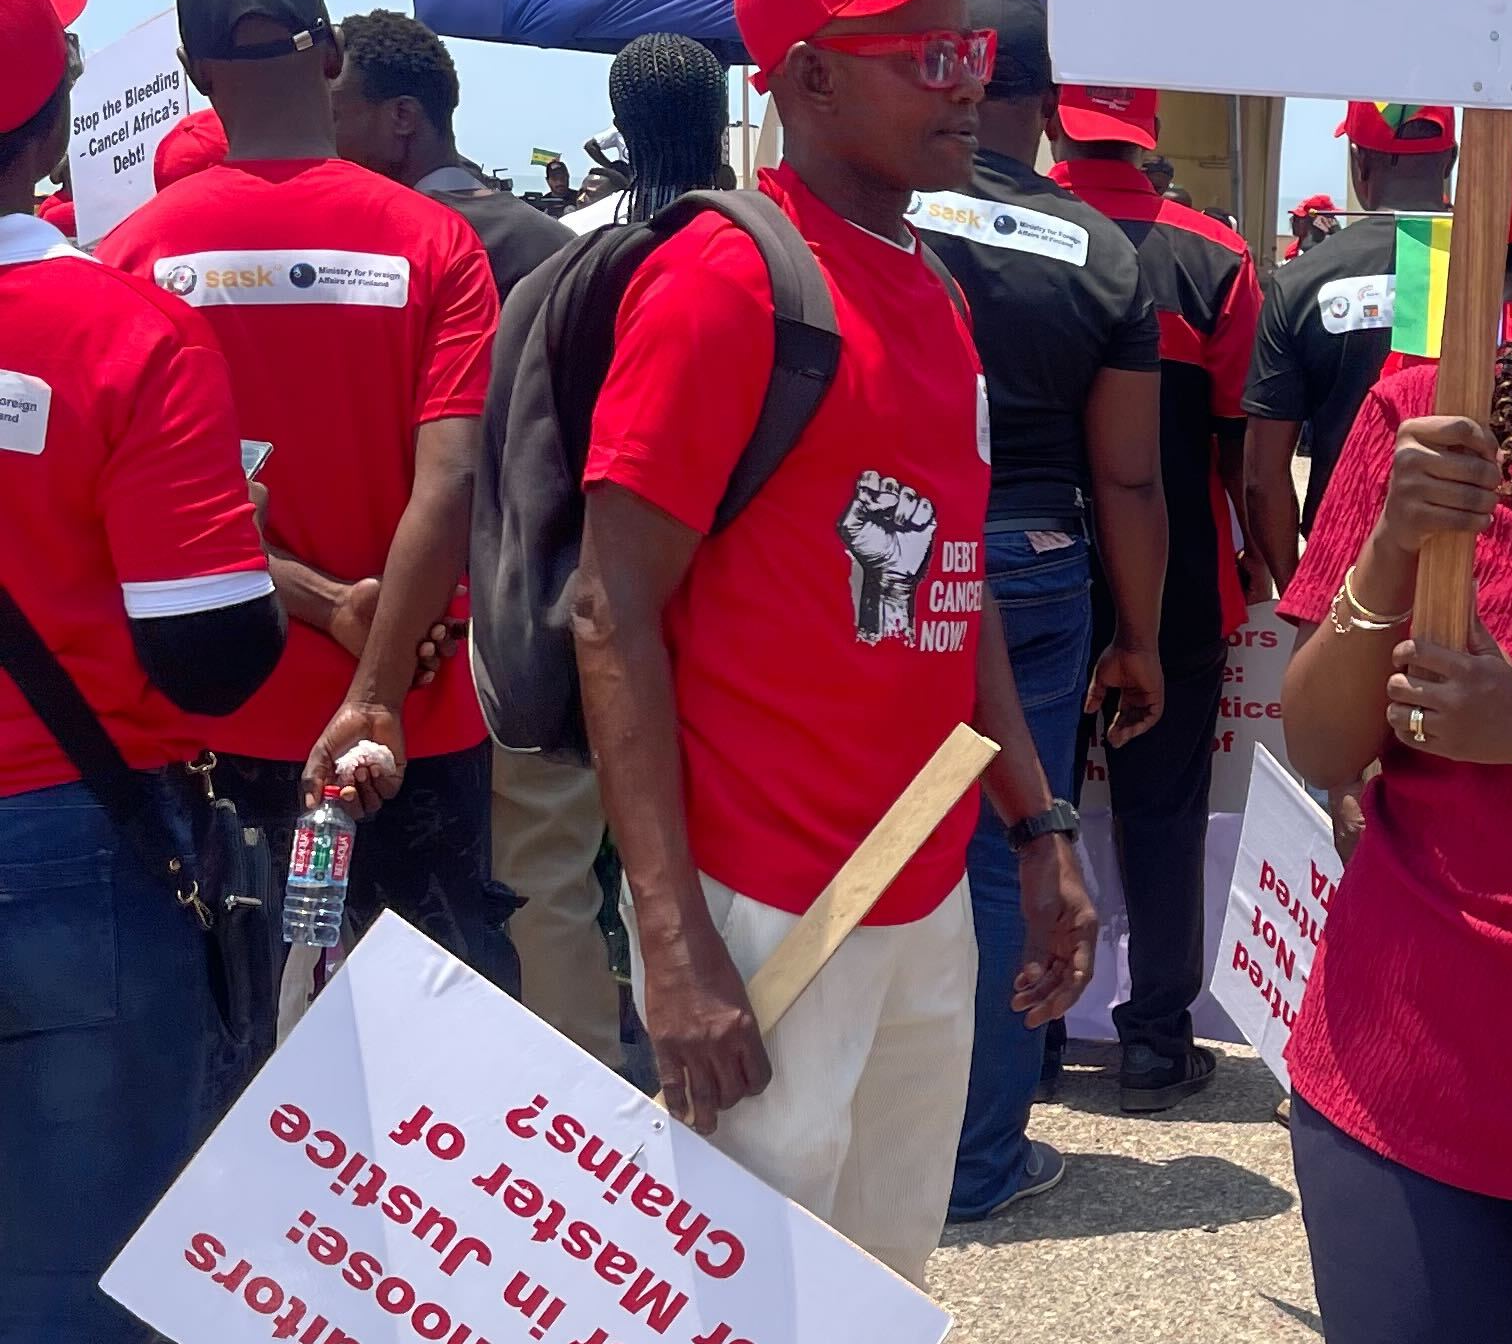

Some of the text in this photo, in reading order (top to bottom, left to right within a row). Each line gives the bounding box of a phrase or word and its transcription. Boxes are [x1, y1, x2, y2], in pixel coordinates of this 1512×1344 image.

[73, 70, 180, 135] Stop the Bleeding
[89, 121, 130, 156] Cancel
[113, 143, 145, 174] Debt!
[928, 203, 981, 230] sask
[205, 265, 274, 289] sask
[318, 266, 353, 278] Ministry
[354, 267, 366, 277] for
[318, 276, 345, 285] Affairs
[347, 277, 356, 286] of
[942, 541, 978, 573] DEBT
[920, 620, 967, 653] NOW!
[1251, 905, 1297, 982] Not
[389, 1105, 466, 1161] of
[269, 1104, 491, 1277] Justice
[505, 1094, 745, 1279] Chains?
[472, 1163, 688, 1334] Master
[504, 1270, 567, 1340] in
